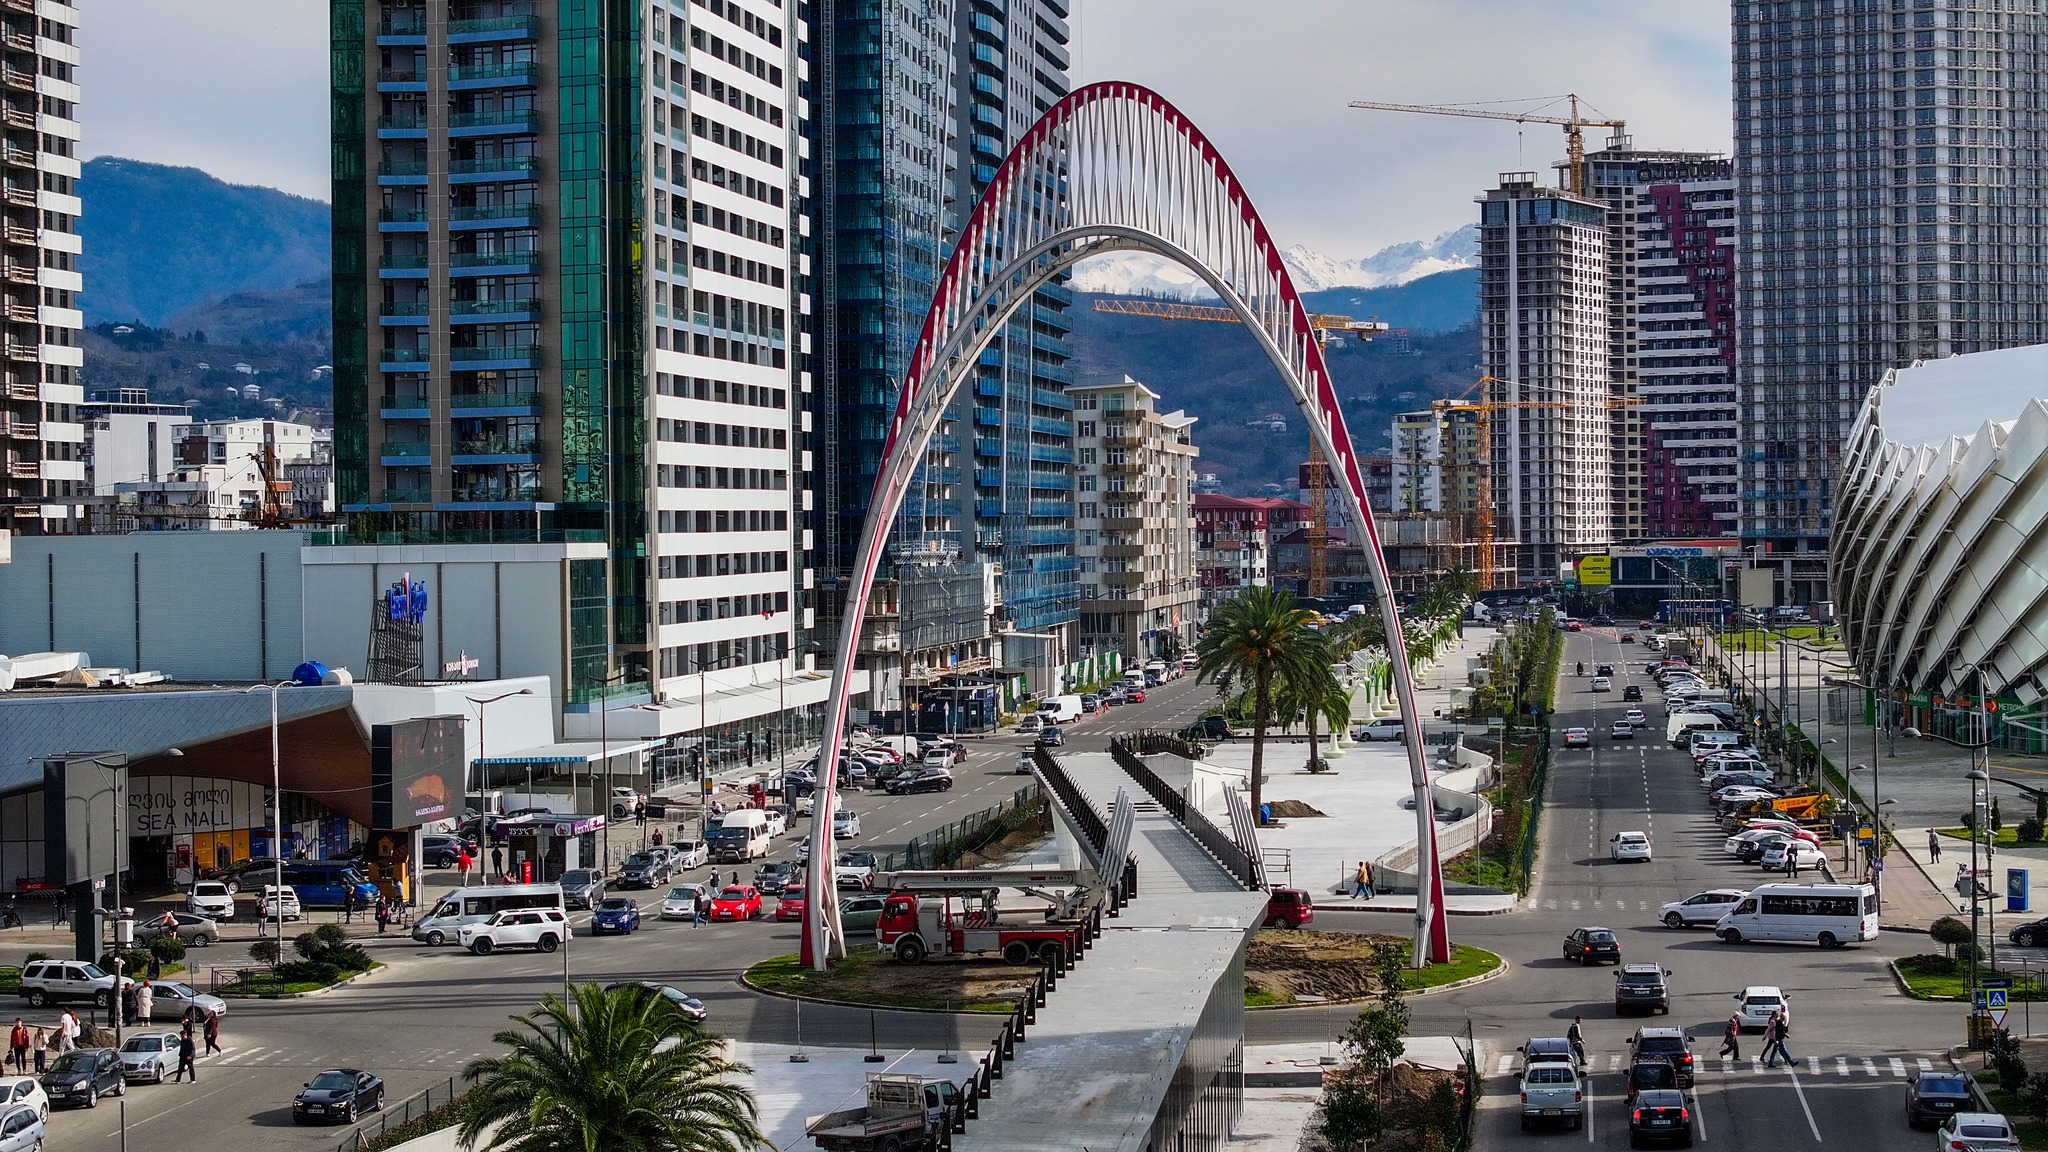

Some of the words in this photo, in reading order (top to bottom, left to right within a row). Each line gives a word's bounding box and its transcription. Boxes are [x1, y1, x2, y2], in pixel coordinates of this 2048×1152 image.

[128, 792, 177, 810] ღვის
[183, 788, 230, 808] მოლი
[137, 813, 177, 831] SEA
[184, 810, 230, 827] MALL
